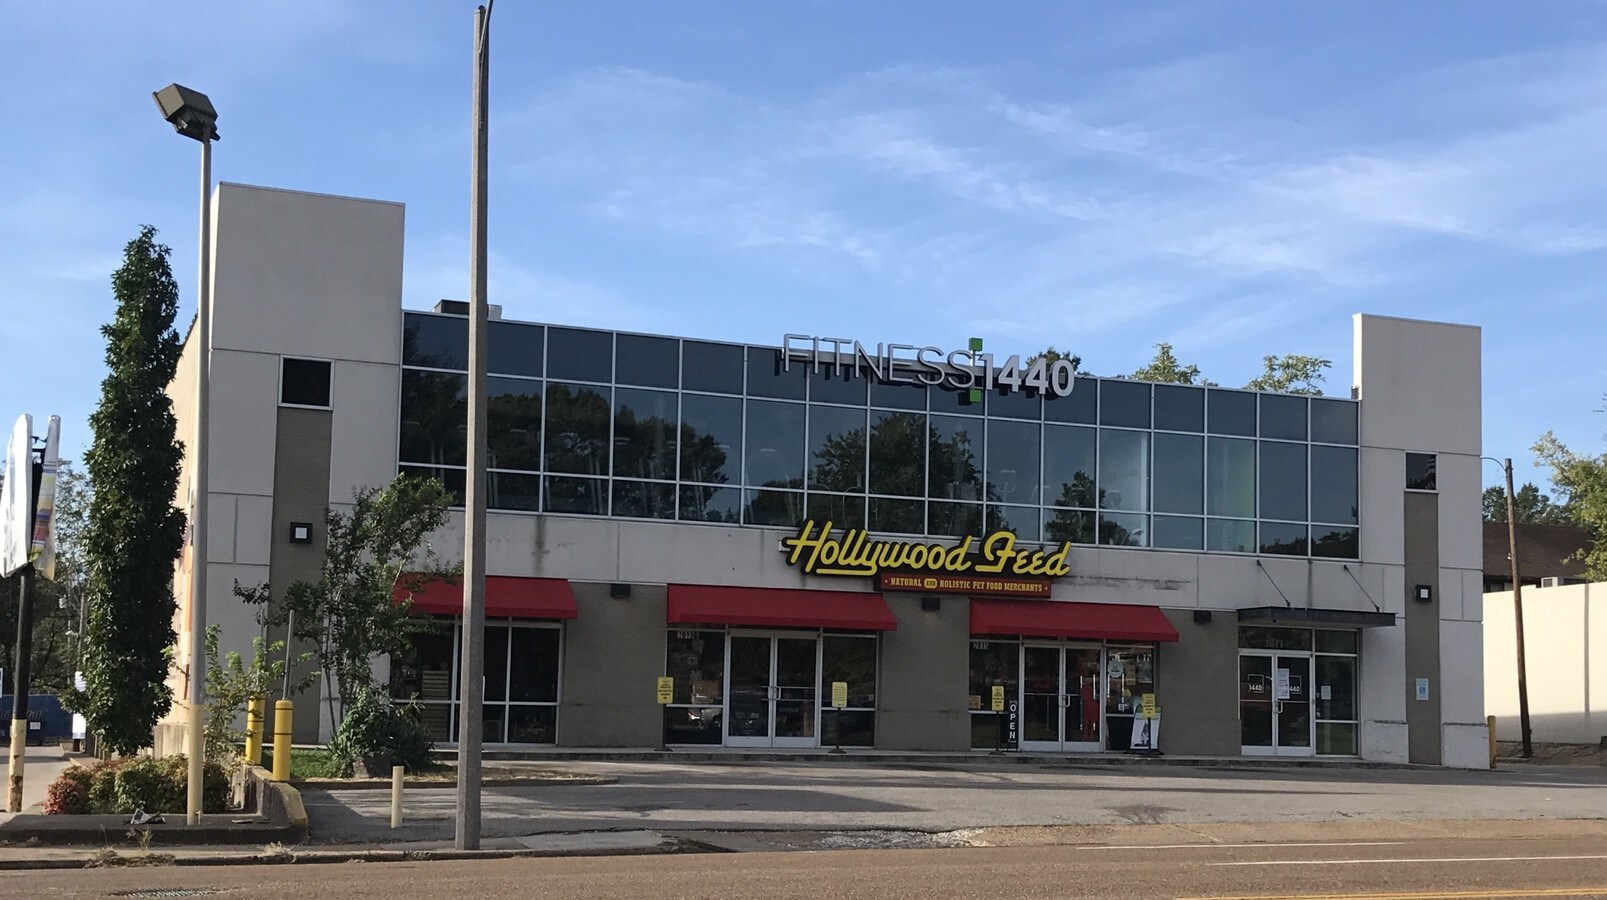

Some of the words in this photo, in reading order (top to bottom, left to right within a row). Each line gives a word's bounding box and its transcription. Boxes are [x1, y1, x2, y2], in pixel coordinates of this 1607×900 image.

[783, 334, 975, 388] FITNESS
[978, 353, 1075, 397] 1440
[787, 520, 972, 576] Hollywood
[974, 531, 1071, 576] Feed
[890, 577, 922, 587] NATURAL
[939, 578, 971, 589] HOLISTIC
[972, 580, 985, 590] PET
[986, 580, 1003, 591] FOOD
[1003, 581, 1043, 592] MERCHANTS
[1009, 704, 1017, 740] OPEN
